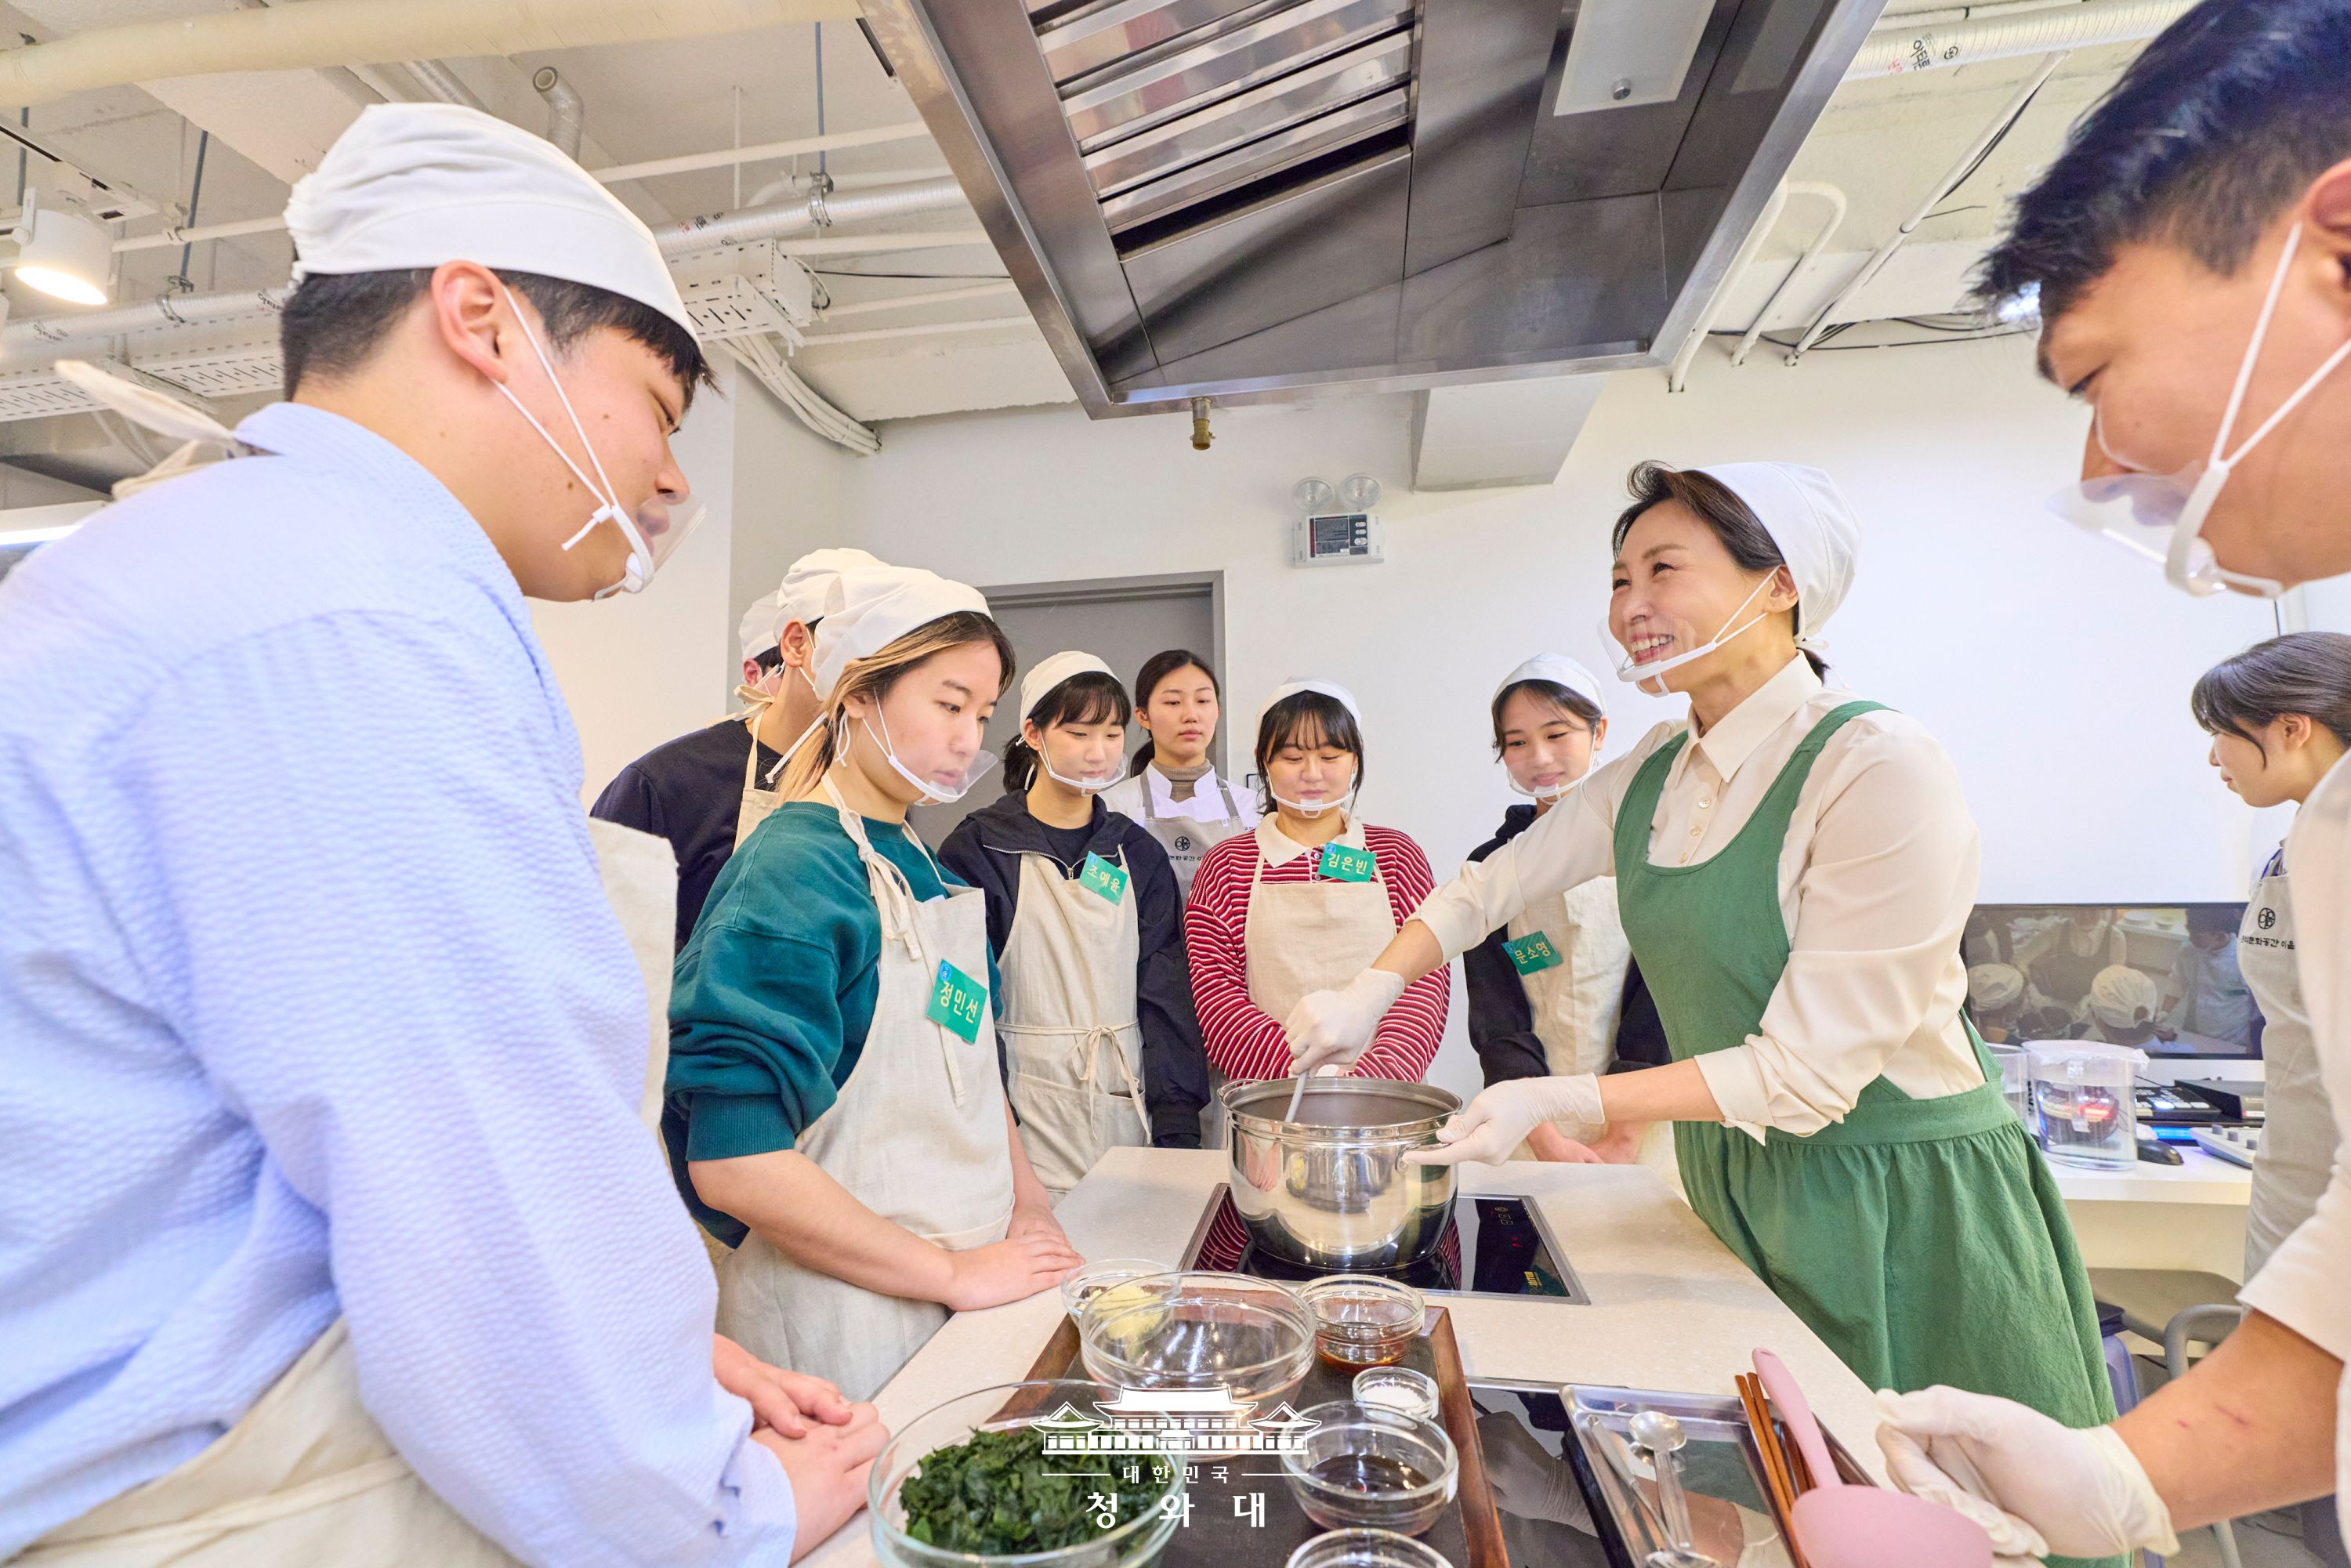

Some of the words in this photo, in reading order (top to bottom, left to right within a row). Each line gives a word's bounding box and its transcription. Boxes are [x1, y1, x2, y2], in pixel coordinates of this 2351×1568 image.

[1328, 853, 1367, 875] 김은빈
[1087, 864, 1120, 893] 조예윤
[1514, 941, 1551, 965] 문소영
[940, 981, 979, 1024] 정민선
